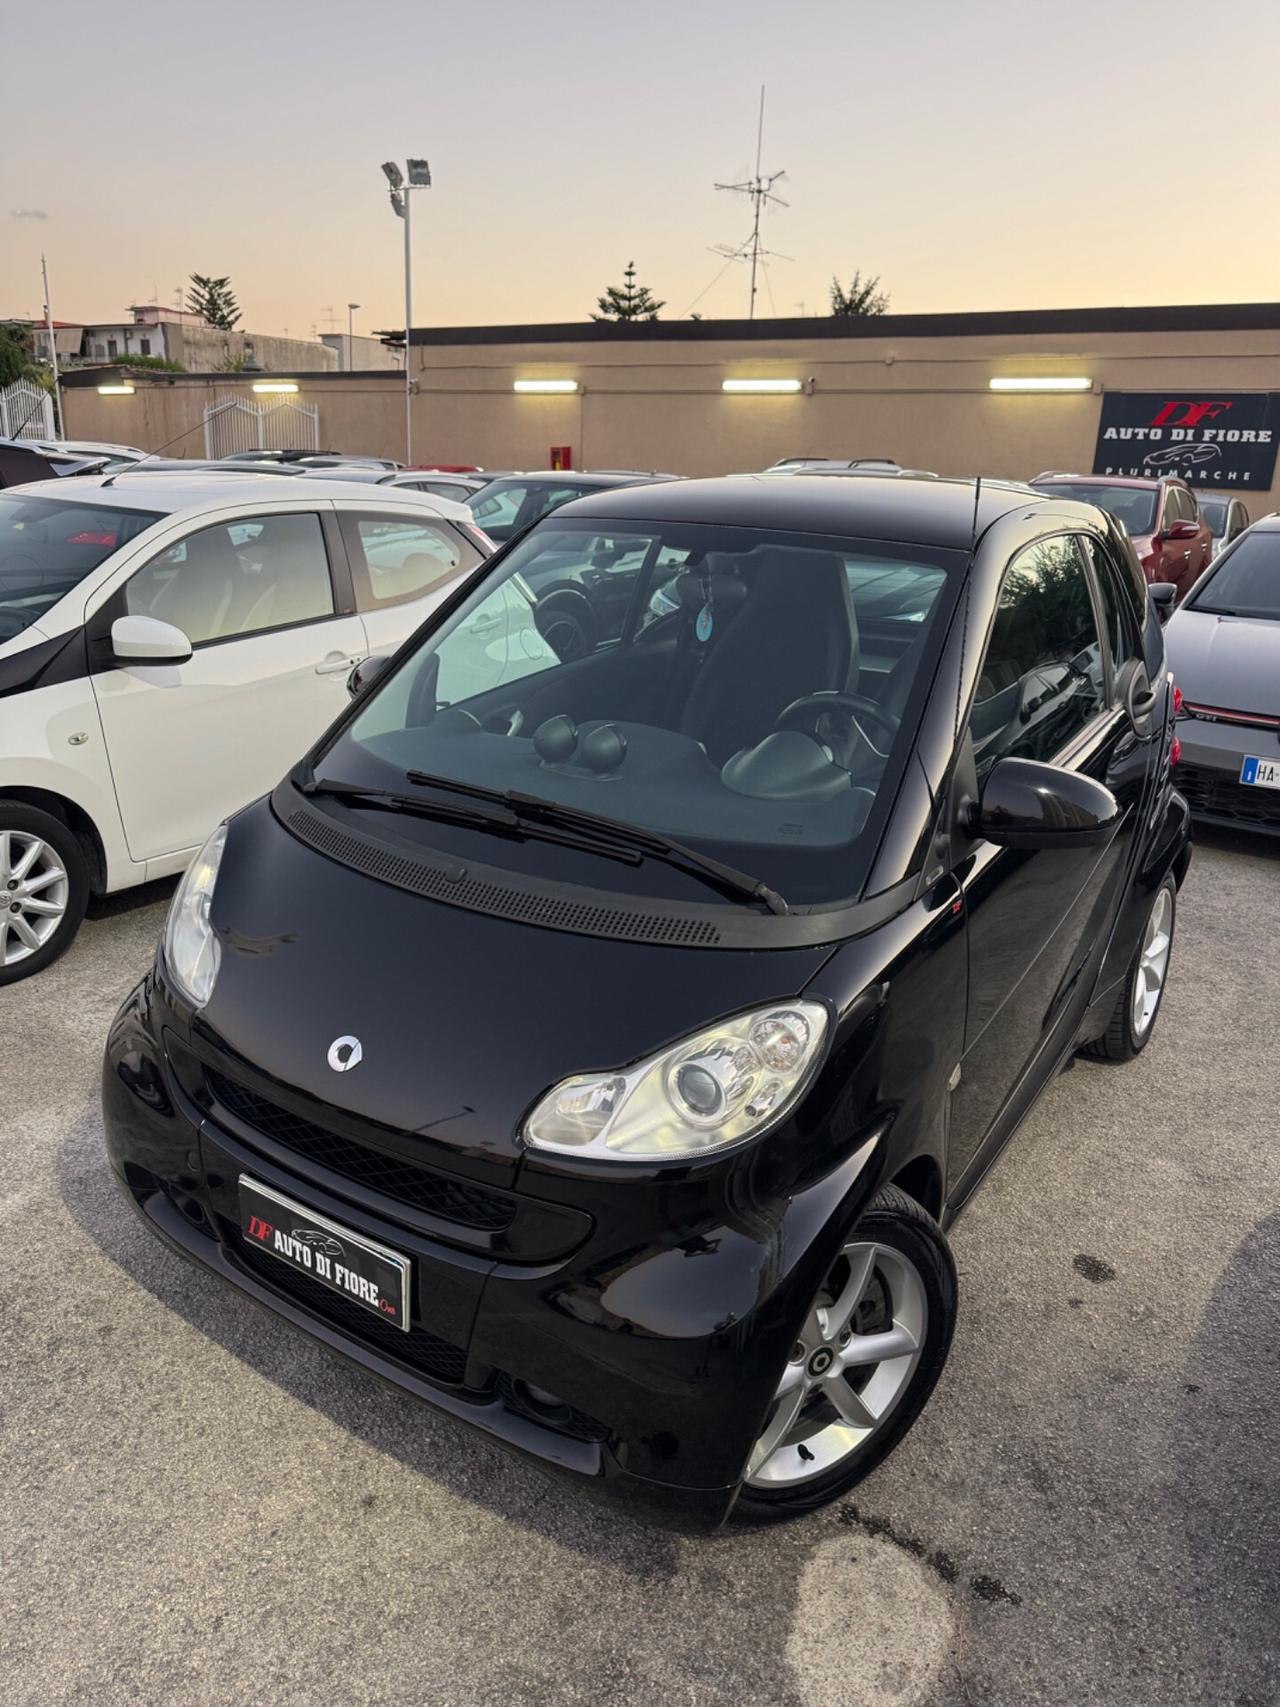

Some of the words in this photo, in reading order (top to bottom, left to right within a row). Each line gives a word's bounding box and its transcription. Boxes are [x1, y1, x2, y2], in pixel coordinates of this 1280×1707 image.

[1148, 401, 1232, 427] DF
[1103, 428, 1162, 440] AUTO
[1170, 428, 1194, 441] DI
[1202, 430, 1273, 442] FIORE
[1105, 467, 1251, 481] PLURIMARCHE
[274, 1230, 311, 1268] AUTO
[315, 1252, 331, 1279] DI
[335, 1263, 379, 1307] FIORE
